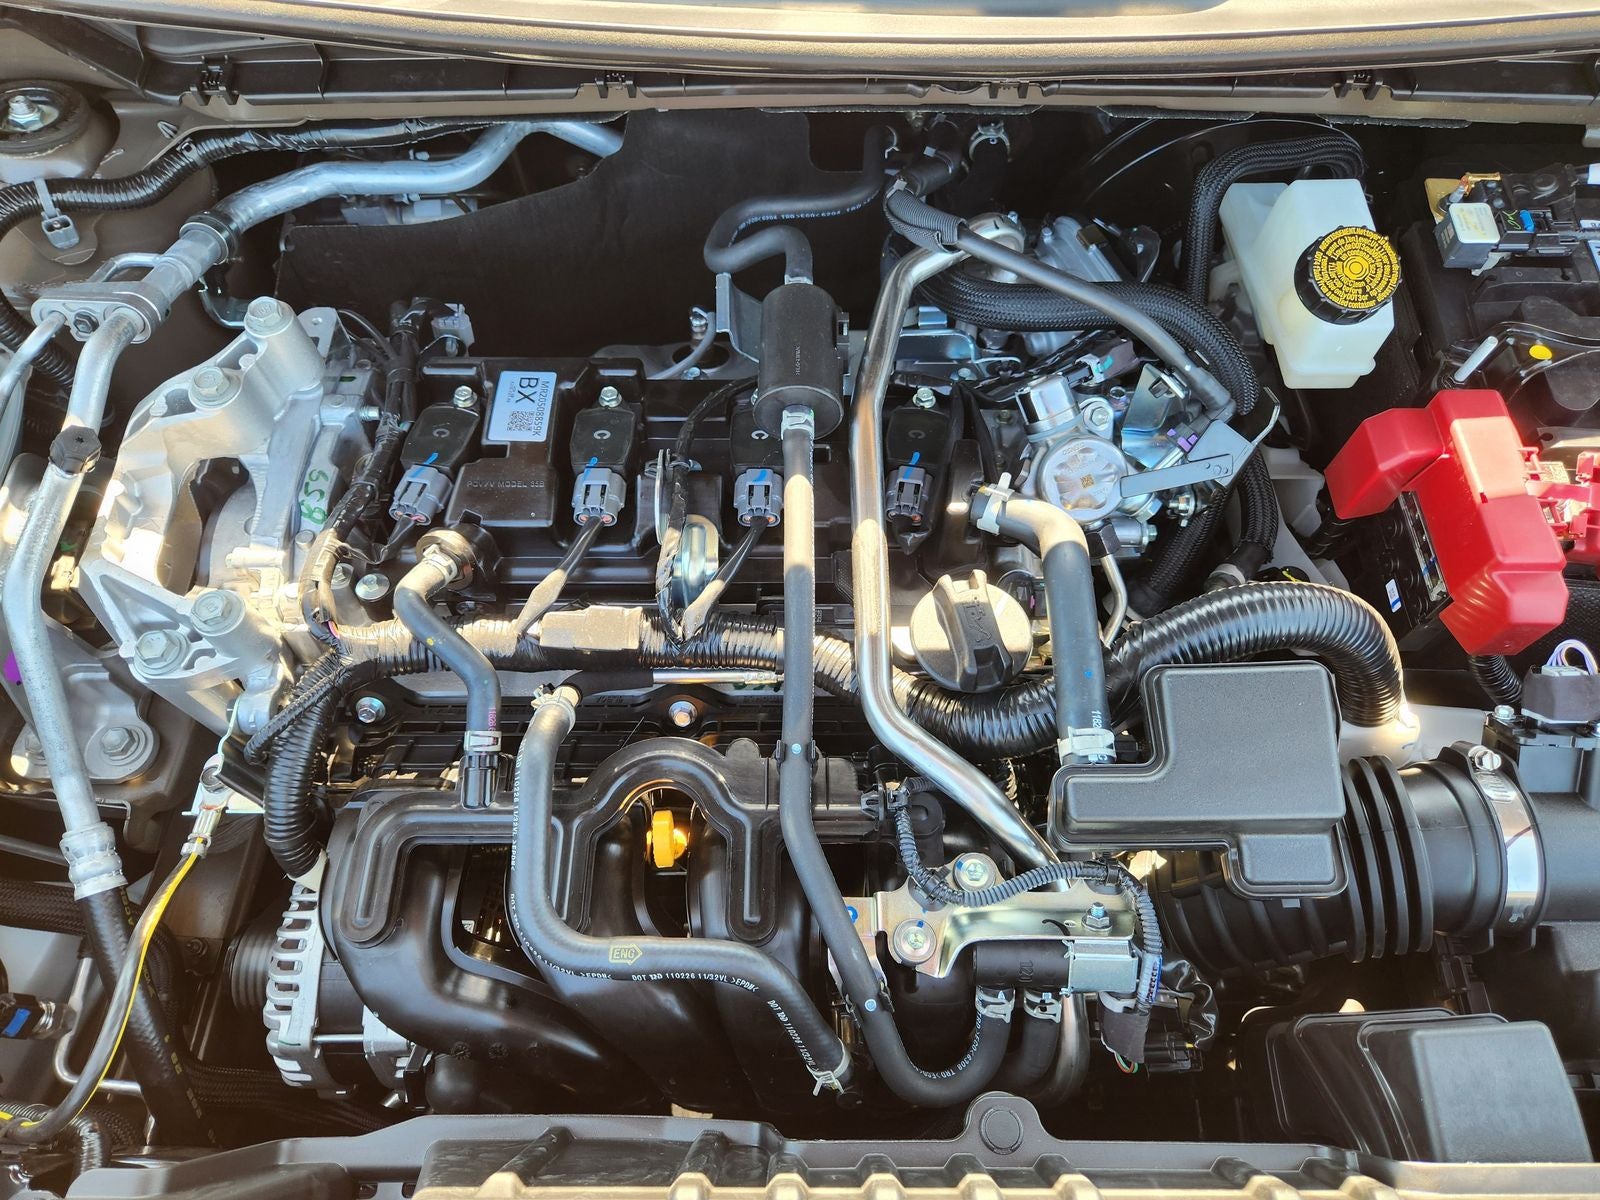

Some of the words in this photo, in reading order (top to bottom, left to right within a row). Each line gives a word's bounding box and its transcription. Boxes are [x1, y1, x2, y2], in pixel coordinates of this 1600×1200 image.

[515, 377, 540, 404] BX
[497, 480, 527, 488] MODEL
[613, 948, 635, 959] ENG
